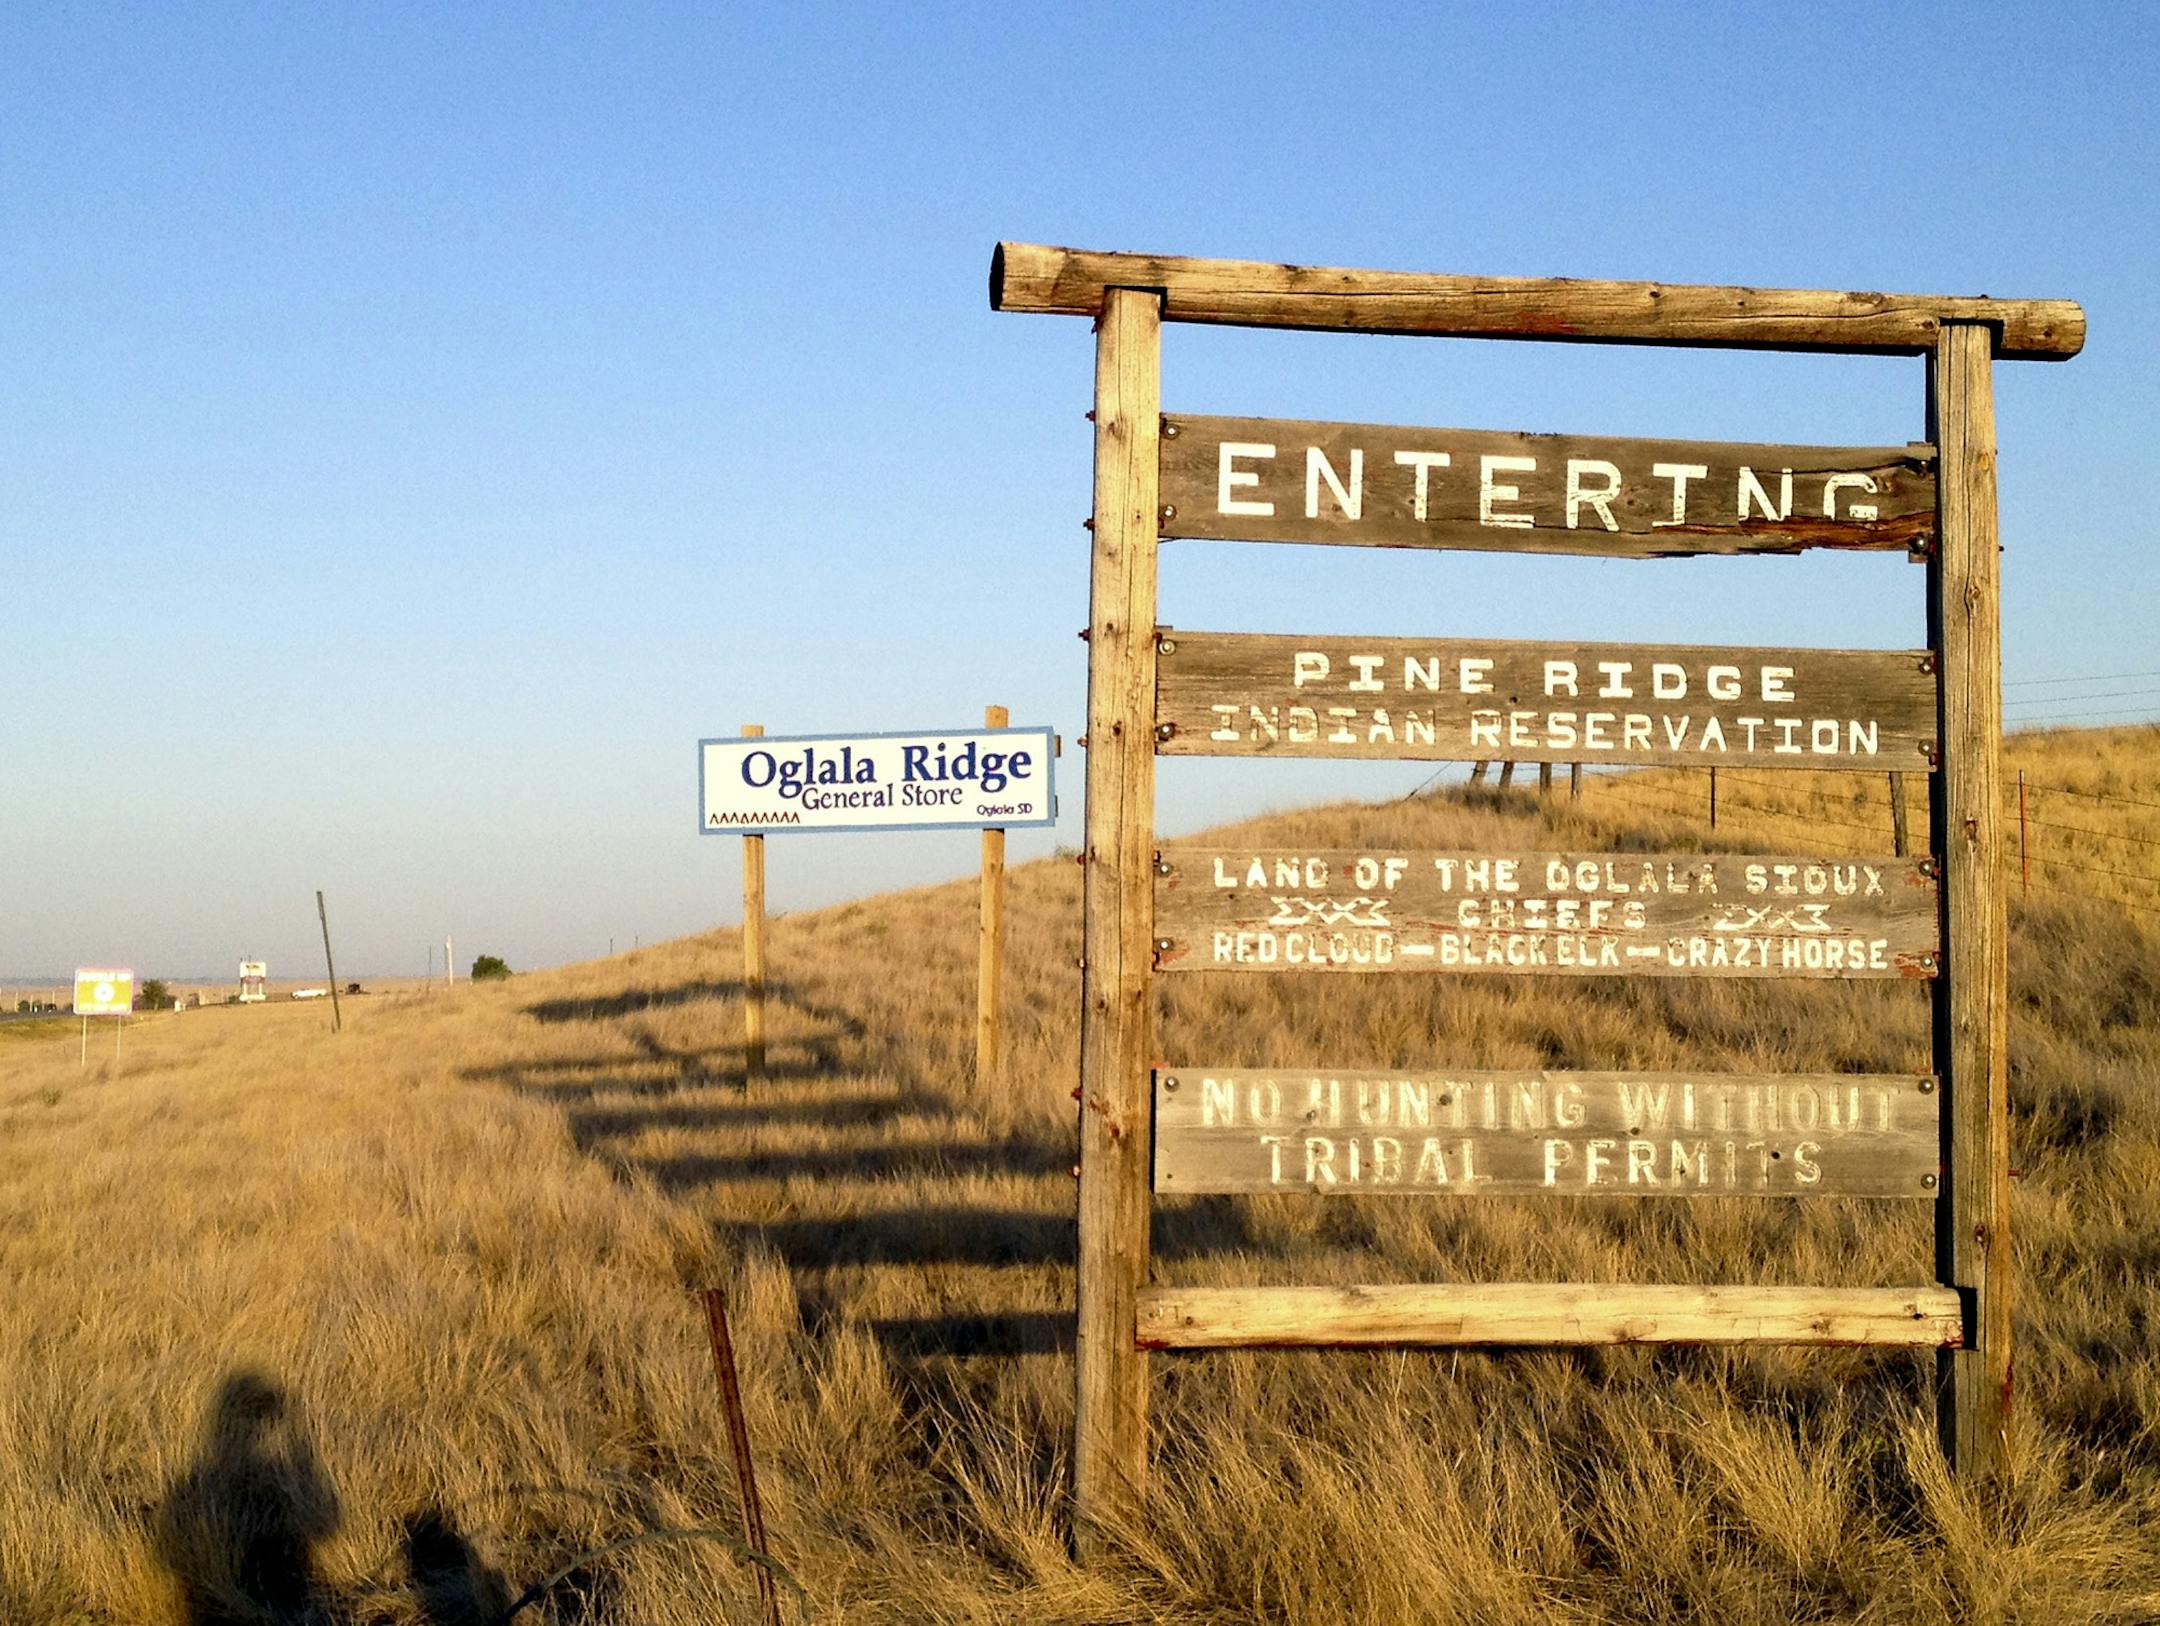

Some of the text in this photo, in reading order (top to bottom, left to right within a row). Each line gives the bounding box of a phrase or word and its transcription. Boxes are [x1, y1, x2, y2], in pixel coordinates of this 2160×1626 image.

[1217, 442, 1878, 533] ENTERING
[1294, 651, 1796, 701] PINE RIDGE
[1210, 704, 1878, 755] INDIAN RESERVATION
[741, 741, 1032, 798] Oglala Ridge
[801, 783, 963, 810] General Store
[976, 803, 1033, 817] Oglala SD
[1213, 857, 1885, 897] LAND OF THE OGLALA SIOUX
[1457, 899, 1647, 930] CHIEFS
[1202, 1078, 1900, 1131] NO HUNTING WITHOUT
[1260, 1136, 1823, 1187] TRIBAL PERMITS
